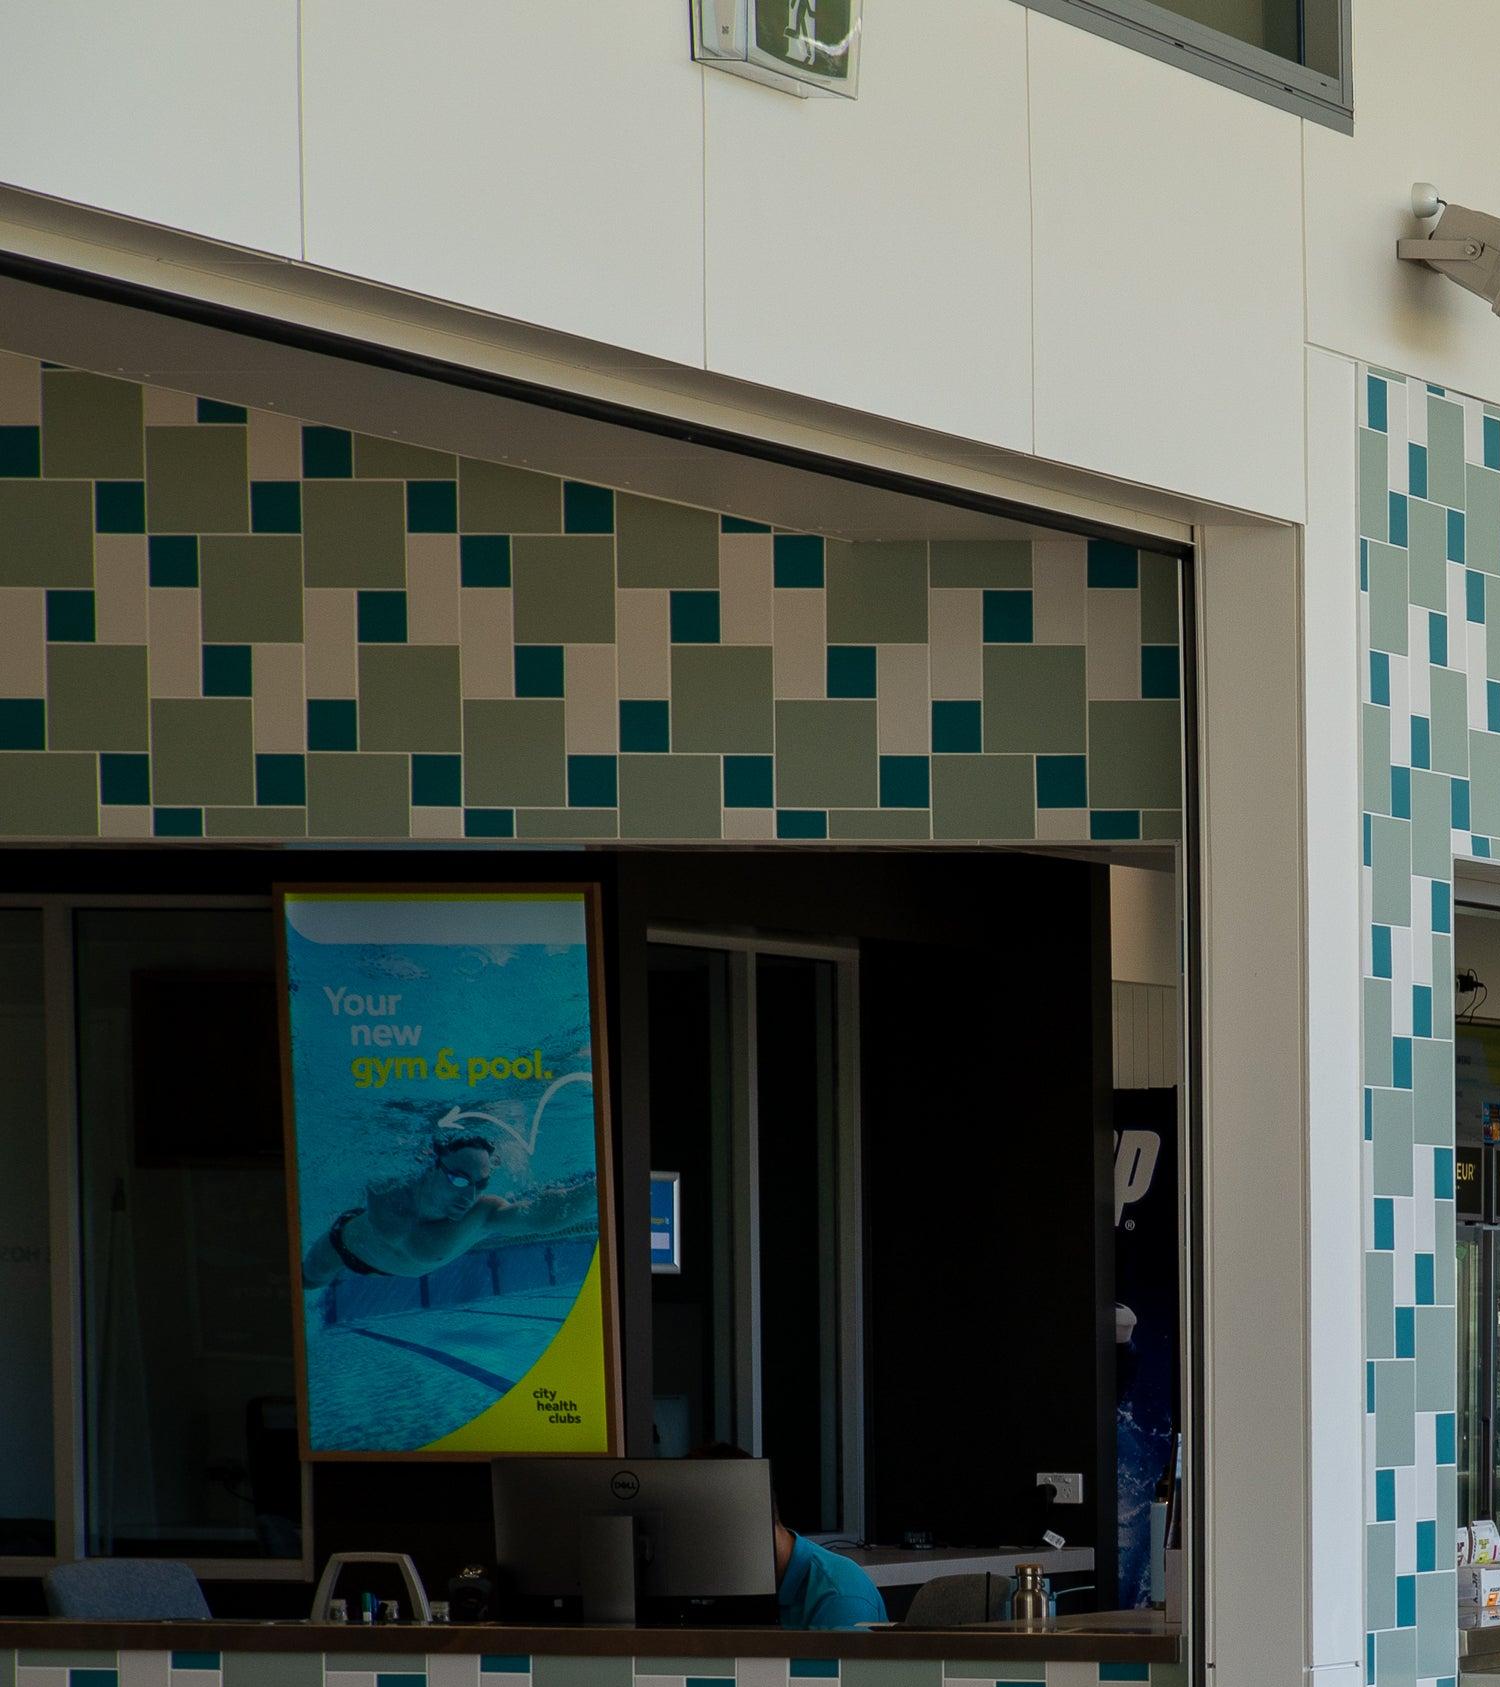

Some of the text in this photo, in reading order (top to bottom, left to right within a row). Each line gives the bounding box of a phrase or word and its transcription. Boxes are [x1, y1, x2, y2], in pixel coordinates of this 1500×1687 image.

[324, 985, 401, 1017] Your
[351, 1025, 422, 1047] new
[351, 1047, 554, 1088] gym & pool.
[533, 1388, 557, 1403] city
[537, 1399, 577, 1413] health
[549, 1411, 582, 1425] clubs
[614, 1480, 638, 1491] DELL
